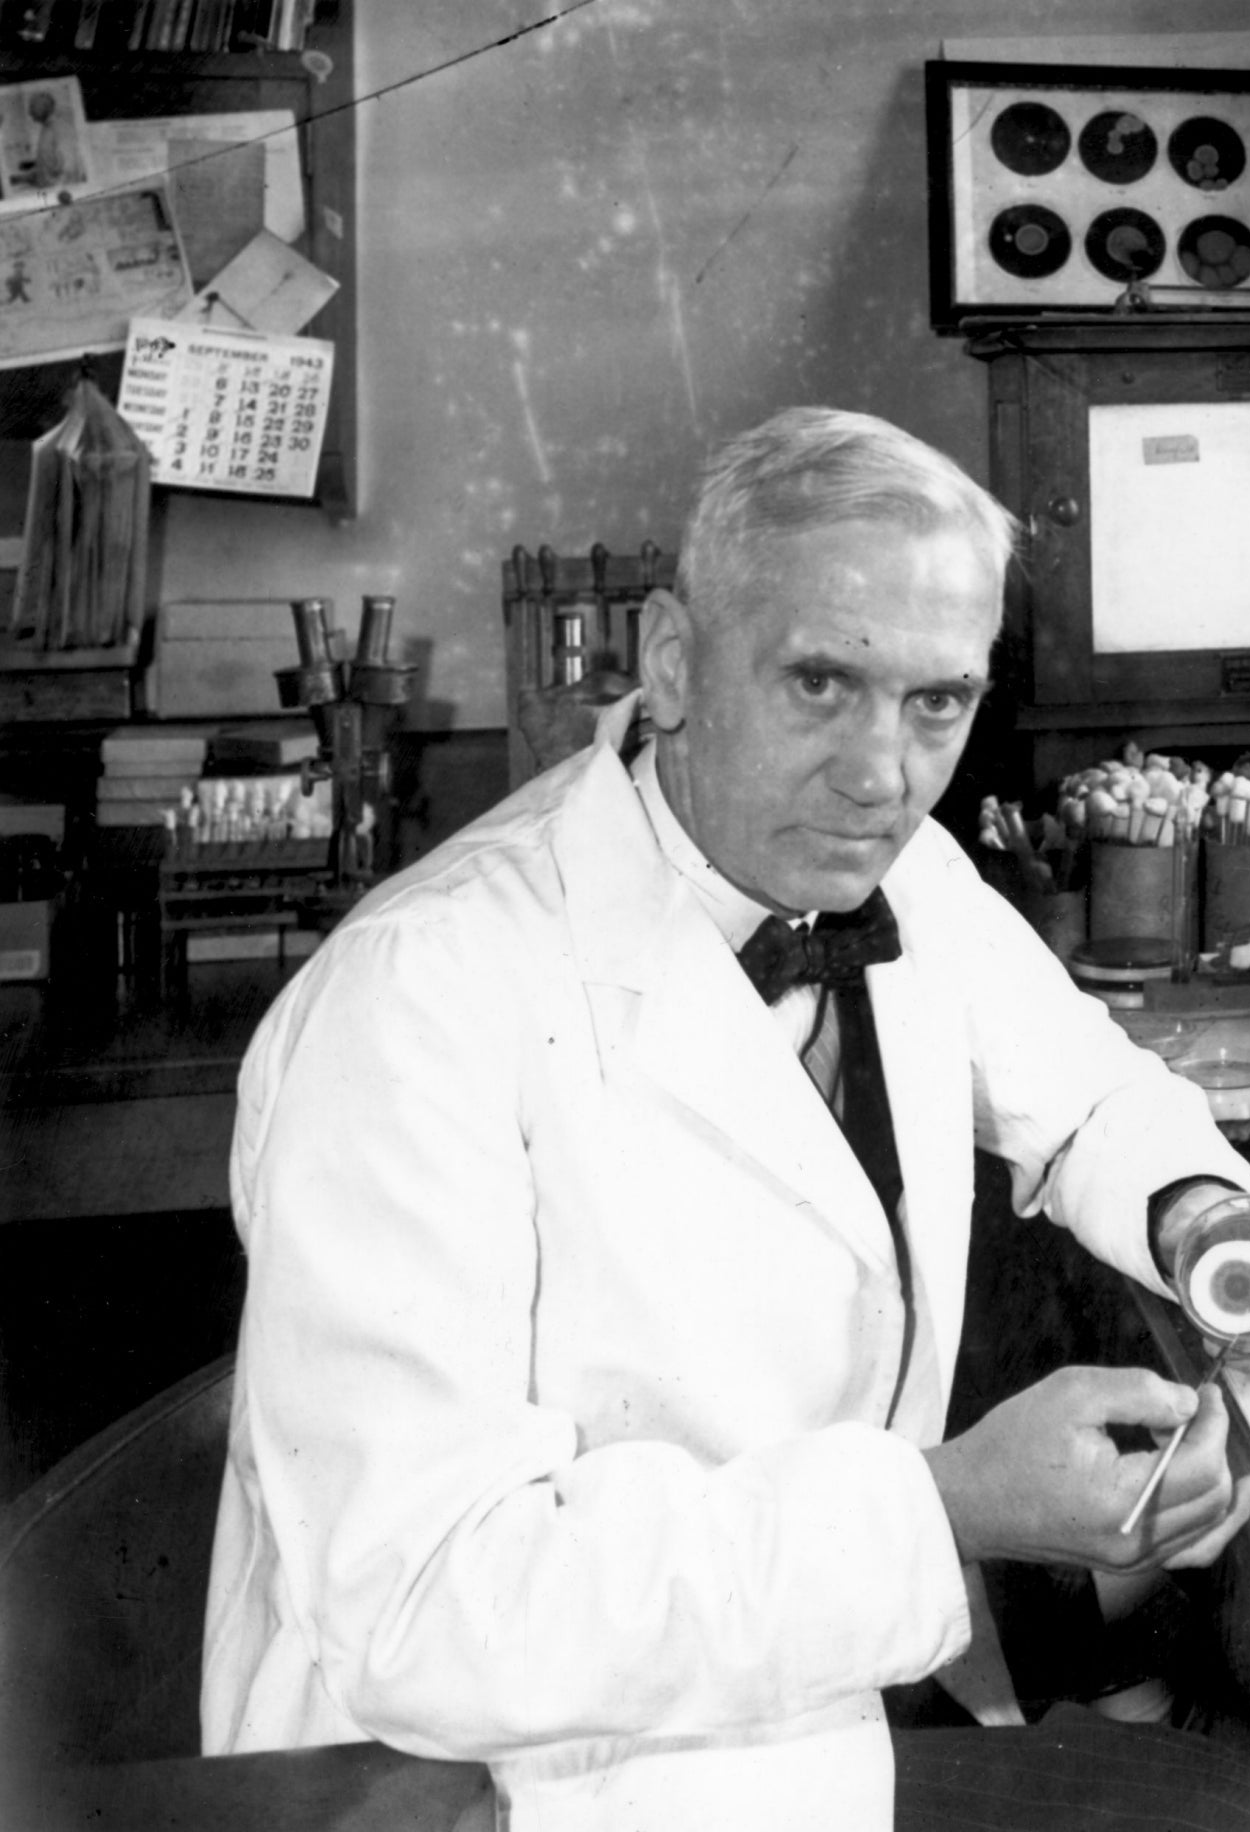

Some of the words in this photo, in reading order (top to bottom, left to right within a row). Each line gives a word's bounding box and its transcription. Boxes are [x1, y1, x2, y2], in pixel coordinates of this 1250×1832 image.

[188, 344, 268, 362] SEPTEMBER
[290, 355, 324, 369] 1943
[127, 370, 168, 381] MONDAY
[215, 377, 228, 391] 6
[241, 380, 259, 395] 13
[268, 383, 291, 399] 20
[298, 388, 319, 401] 27
[213, 392, 226, 407] 7
[239, 398, 257, 412] 14
[267, 400, 287, 416] 21
[236, 413, 254, 429] 15
[262, 416, 285, 432] 22
[291, 420, 315, 434] 29
[176, 423, 188, 438] 2
[234, 431, 253, 445] 16
[260, 433, 282, 449] 23
[287, 436, 311, 452] 30
[200, 443, 219, 459] 10
[231, 447, 250, 461] 17
[257, 449, 279, 465] 24
[254, 467, 275, 481] 25
